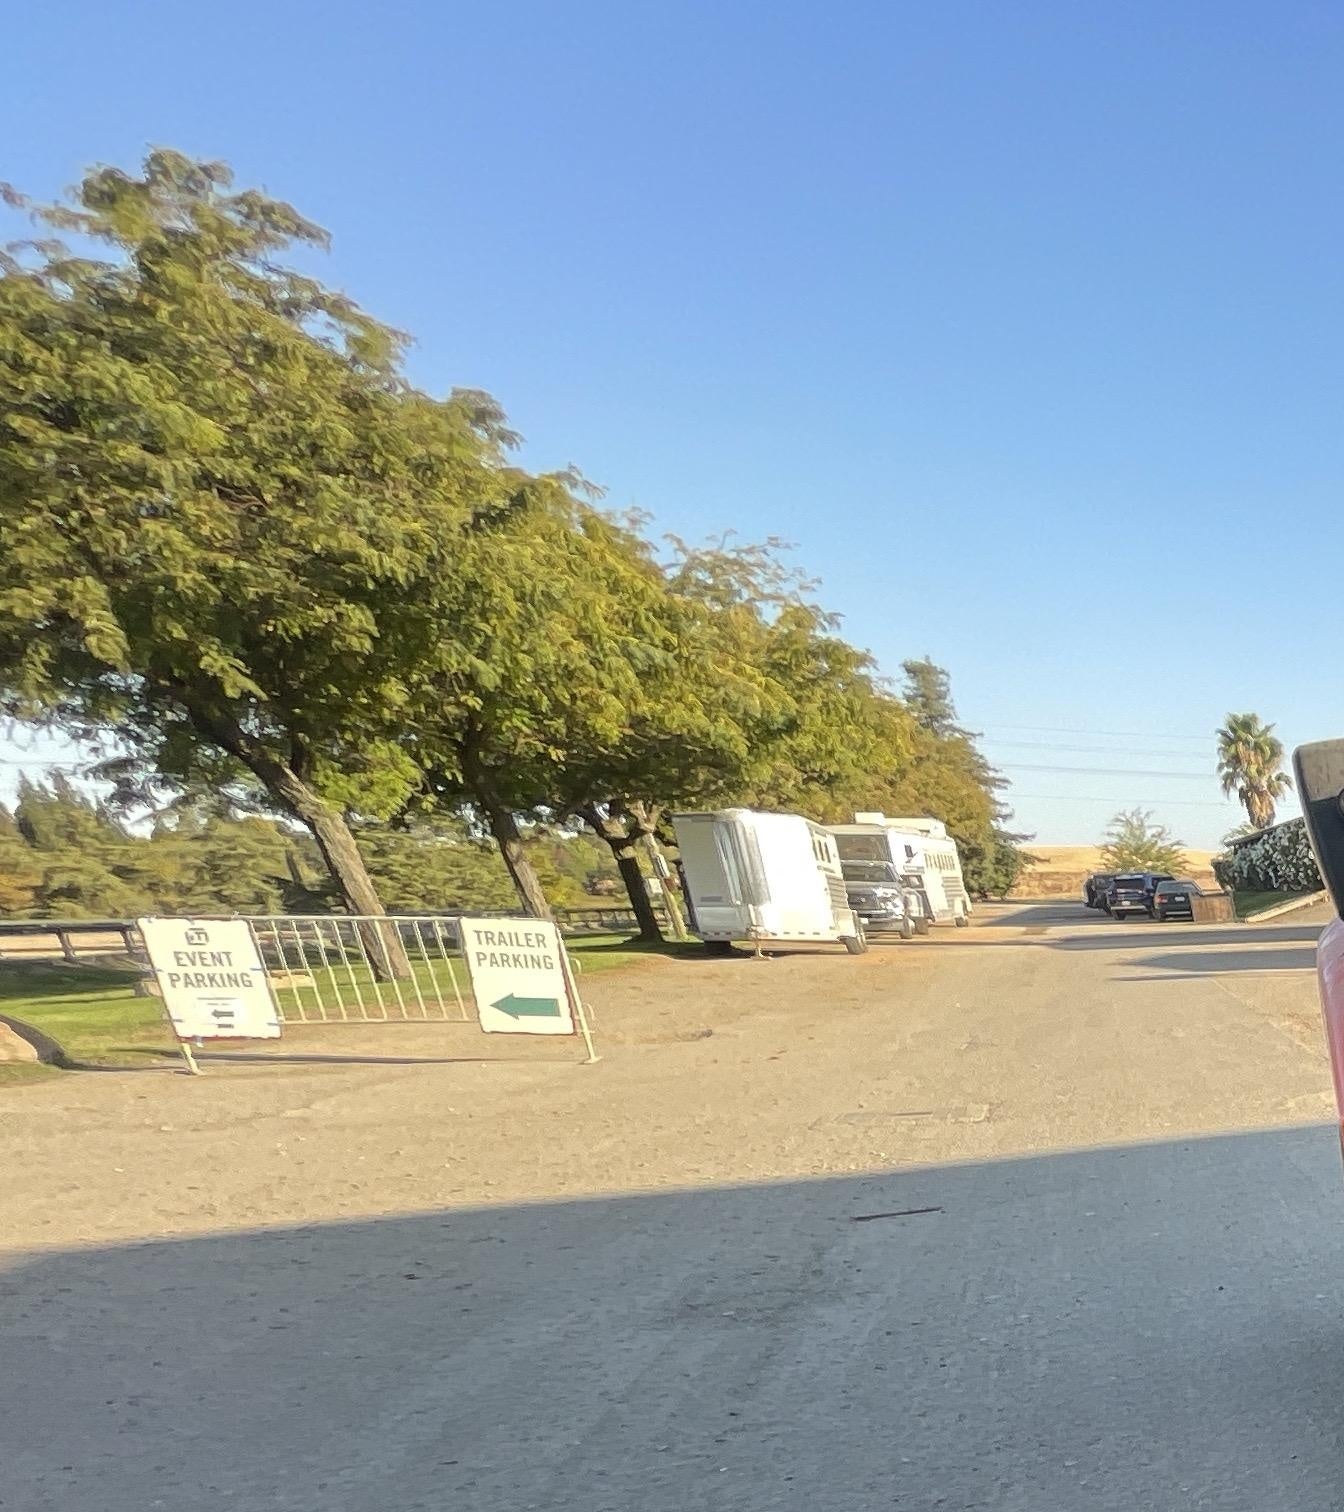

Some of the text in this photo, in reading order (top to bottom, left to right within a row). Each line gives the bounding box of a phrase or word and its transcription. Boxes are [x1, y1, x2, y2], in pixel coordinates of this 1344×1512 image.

[473, 929, 547, 949] TRAILER
[173, 951, 233, 967] EVENT
[475, 951, 554, 970] PARKING
[167, 972, 253, 988] PARKING
